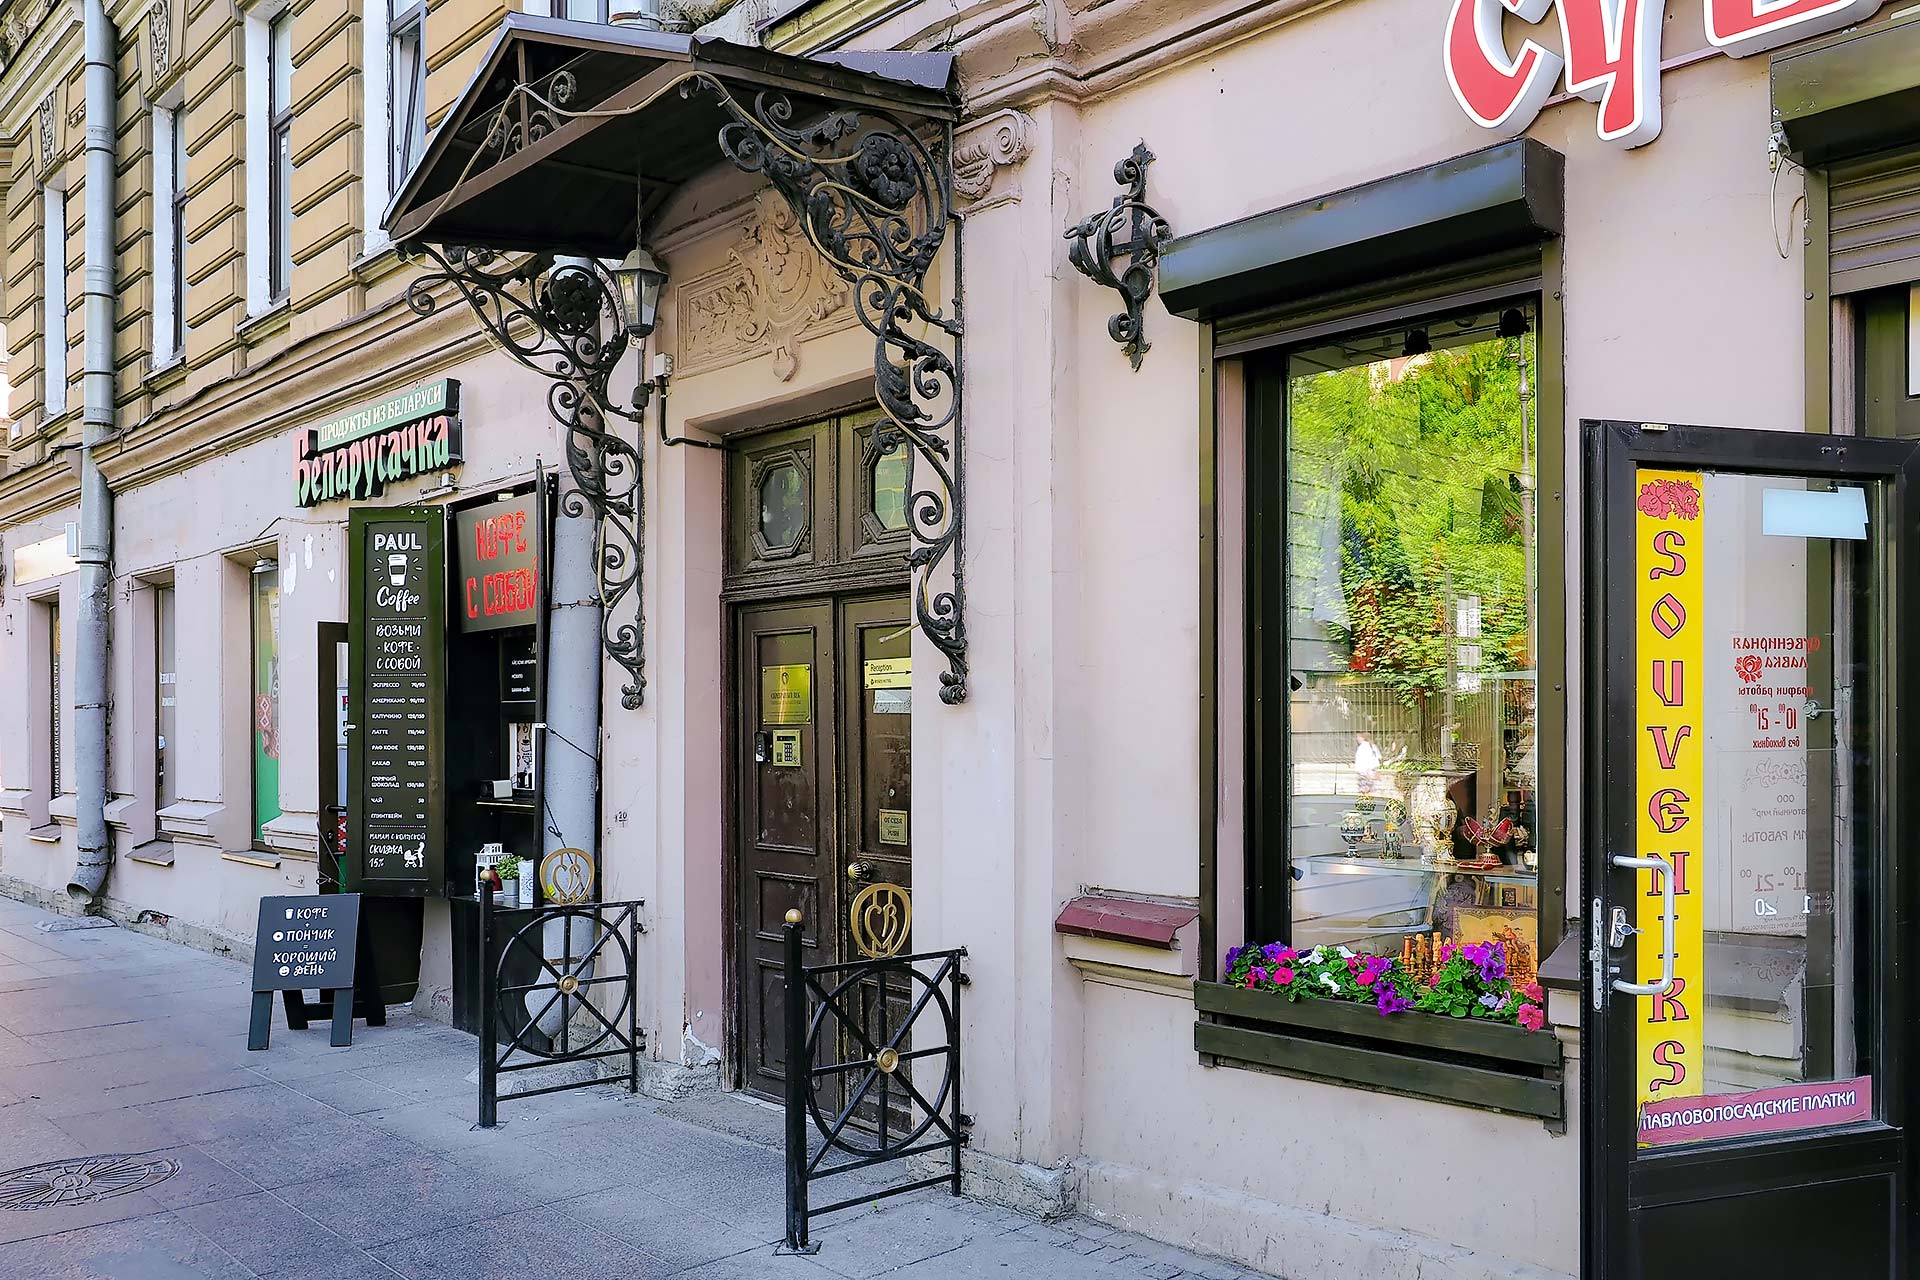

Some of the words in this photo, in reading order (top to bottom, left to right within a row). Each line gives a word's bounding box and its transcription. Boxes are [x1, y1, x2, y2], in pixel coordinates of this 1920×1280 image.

[320, 409, 372, 443] ПРОДУКТЫ
[373, 404, 387, 424] ИЗ
[387, 384, 442, 419] БЕЛАРУСИ
[374, 533, 422, 551] PAUL
[475, 510, 527, 561] КОФЕ
[376, 585, 420, 612] Coffee
[466, 577, 479, 619] С
[375, 624, 422, 637] ВОЗЬМИ
[383, 641, 414, 654] КОФЕ
[376, 657, 384, 670] С
[384, 655, 421, 670] СОБОЙ
[870, 663, 893, 672] Reception
[369, 844, 404, 855] СКИДКА
[369, 858, 385, 869] 15%
[296, 907, 329, 920] КОФЕ
[286, 928, 335, 942] ПОНЧИК
[272, 947, 337, 965] ХОРОШИЙ
[293, 965, 325, 977] ДЕНЬ
[1643, 1096, 1800, 1131] ПАВЛОВОПОСАДСКИЕ
[1802, 1089, 1857, 1112] ПЛАТКИ
